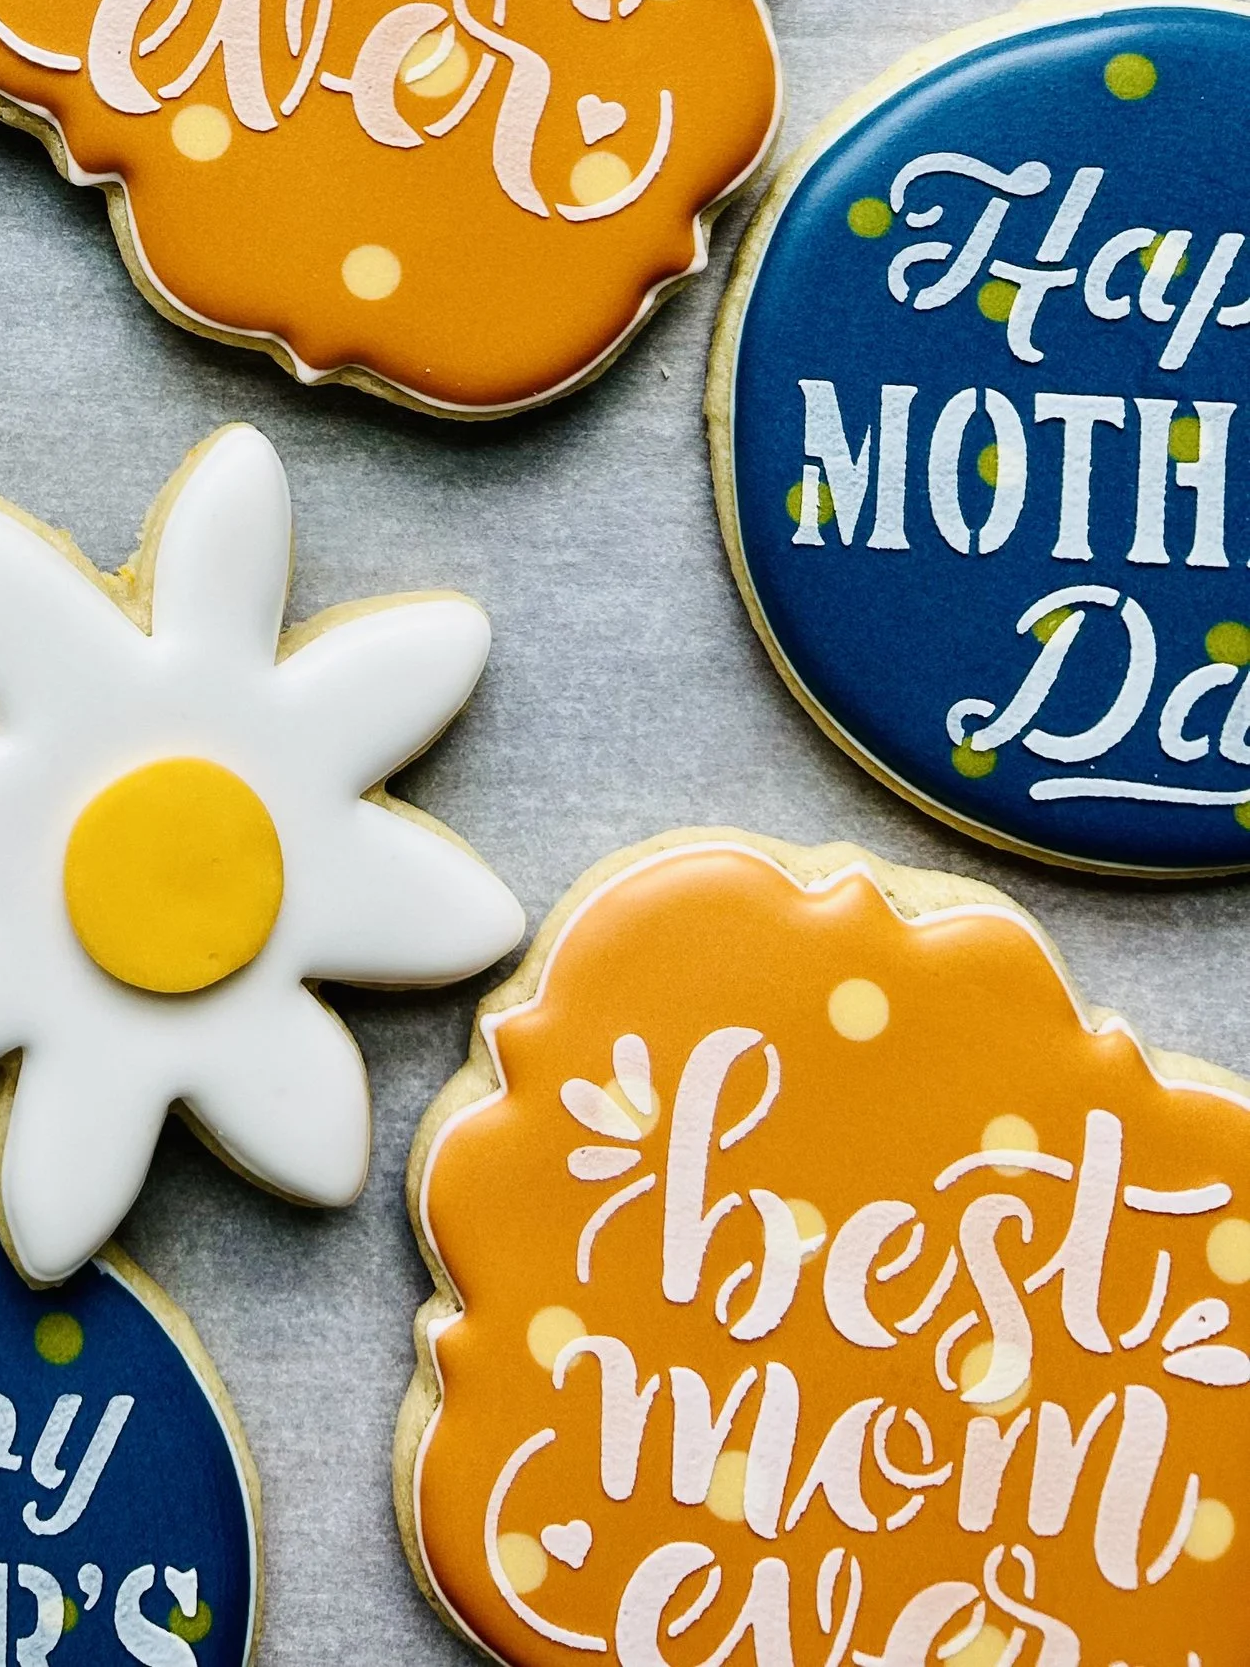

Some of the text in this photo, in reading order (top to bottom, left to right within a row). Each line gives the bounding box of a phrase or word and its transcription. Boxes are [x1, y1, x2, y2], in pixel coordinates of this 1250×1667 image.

[887, 151, 1250, 371] Hap
[791, 378, 1250, 569] MOTH
[946, 584, 1250, 766] Da
[576, 1026, 1233, 1404] best
[552, 1336, 1200, 1590] mom
